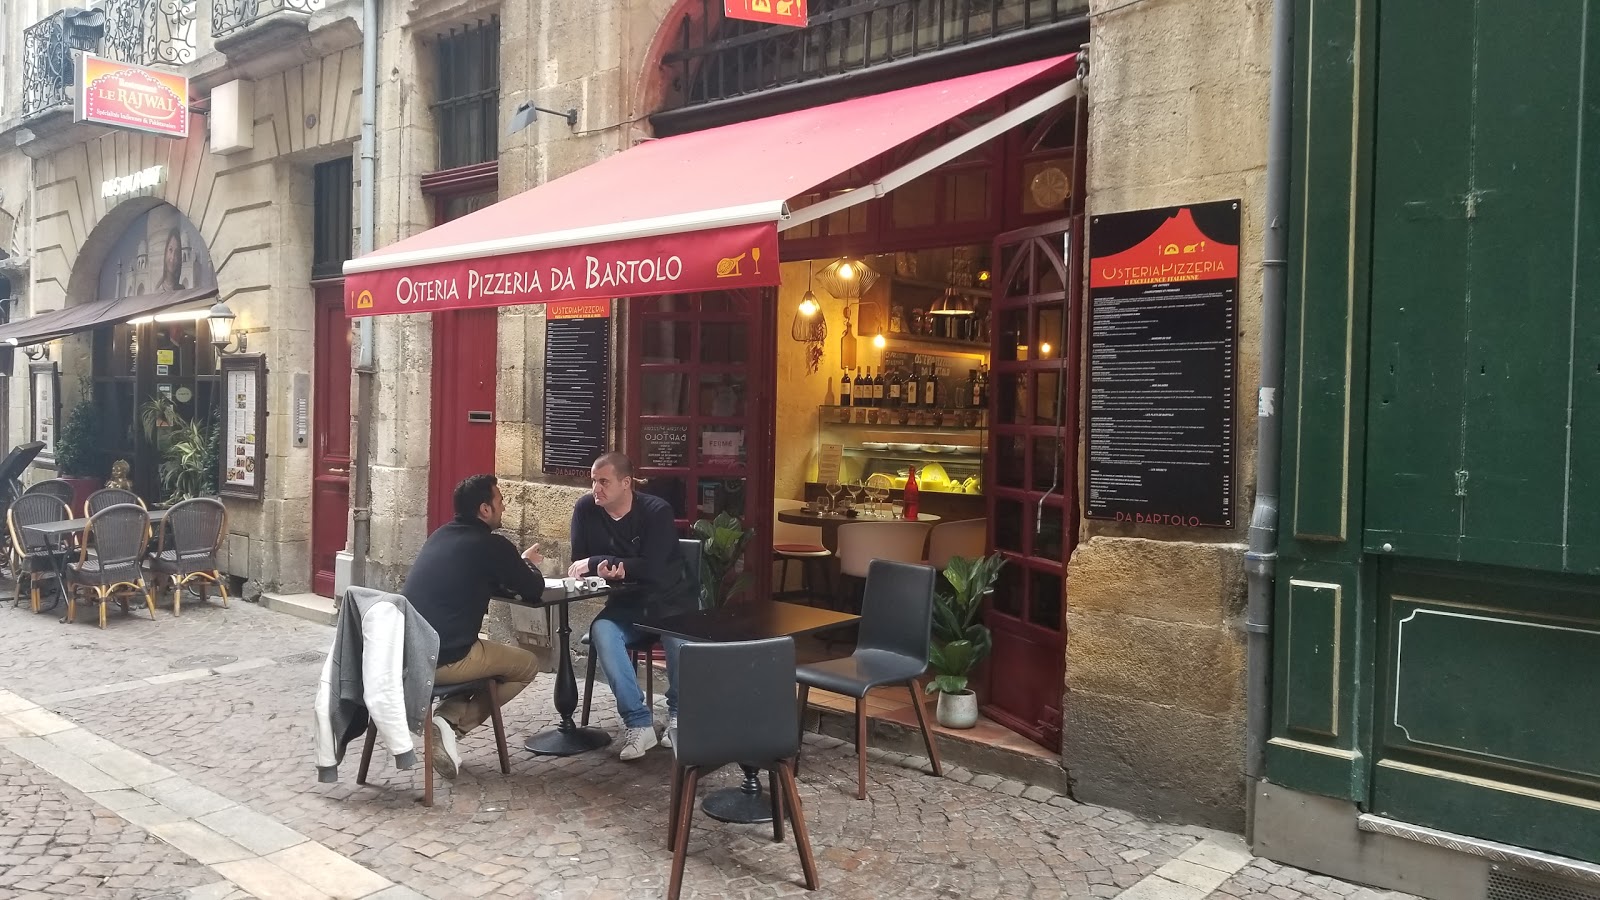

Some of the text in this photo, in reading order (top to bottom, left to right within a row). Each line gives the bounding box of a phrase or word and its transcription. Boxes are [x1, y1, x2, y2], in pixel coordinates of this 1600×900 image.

[98, 88, 177, 118] LE RAJWAL
[143, 117, 149, 125] &
[396, 255, 683, 305] OSTERIA PIZZERIA DA BARTOLO
[1115, 511, 1200, 527] DA BARTOLO
